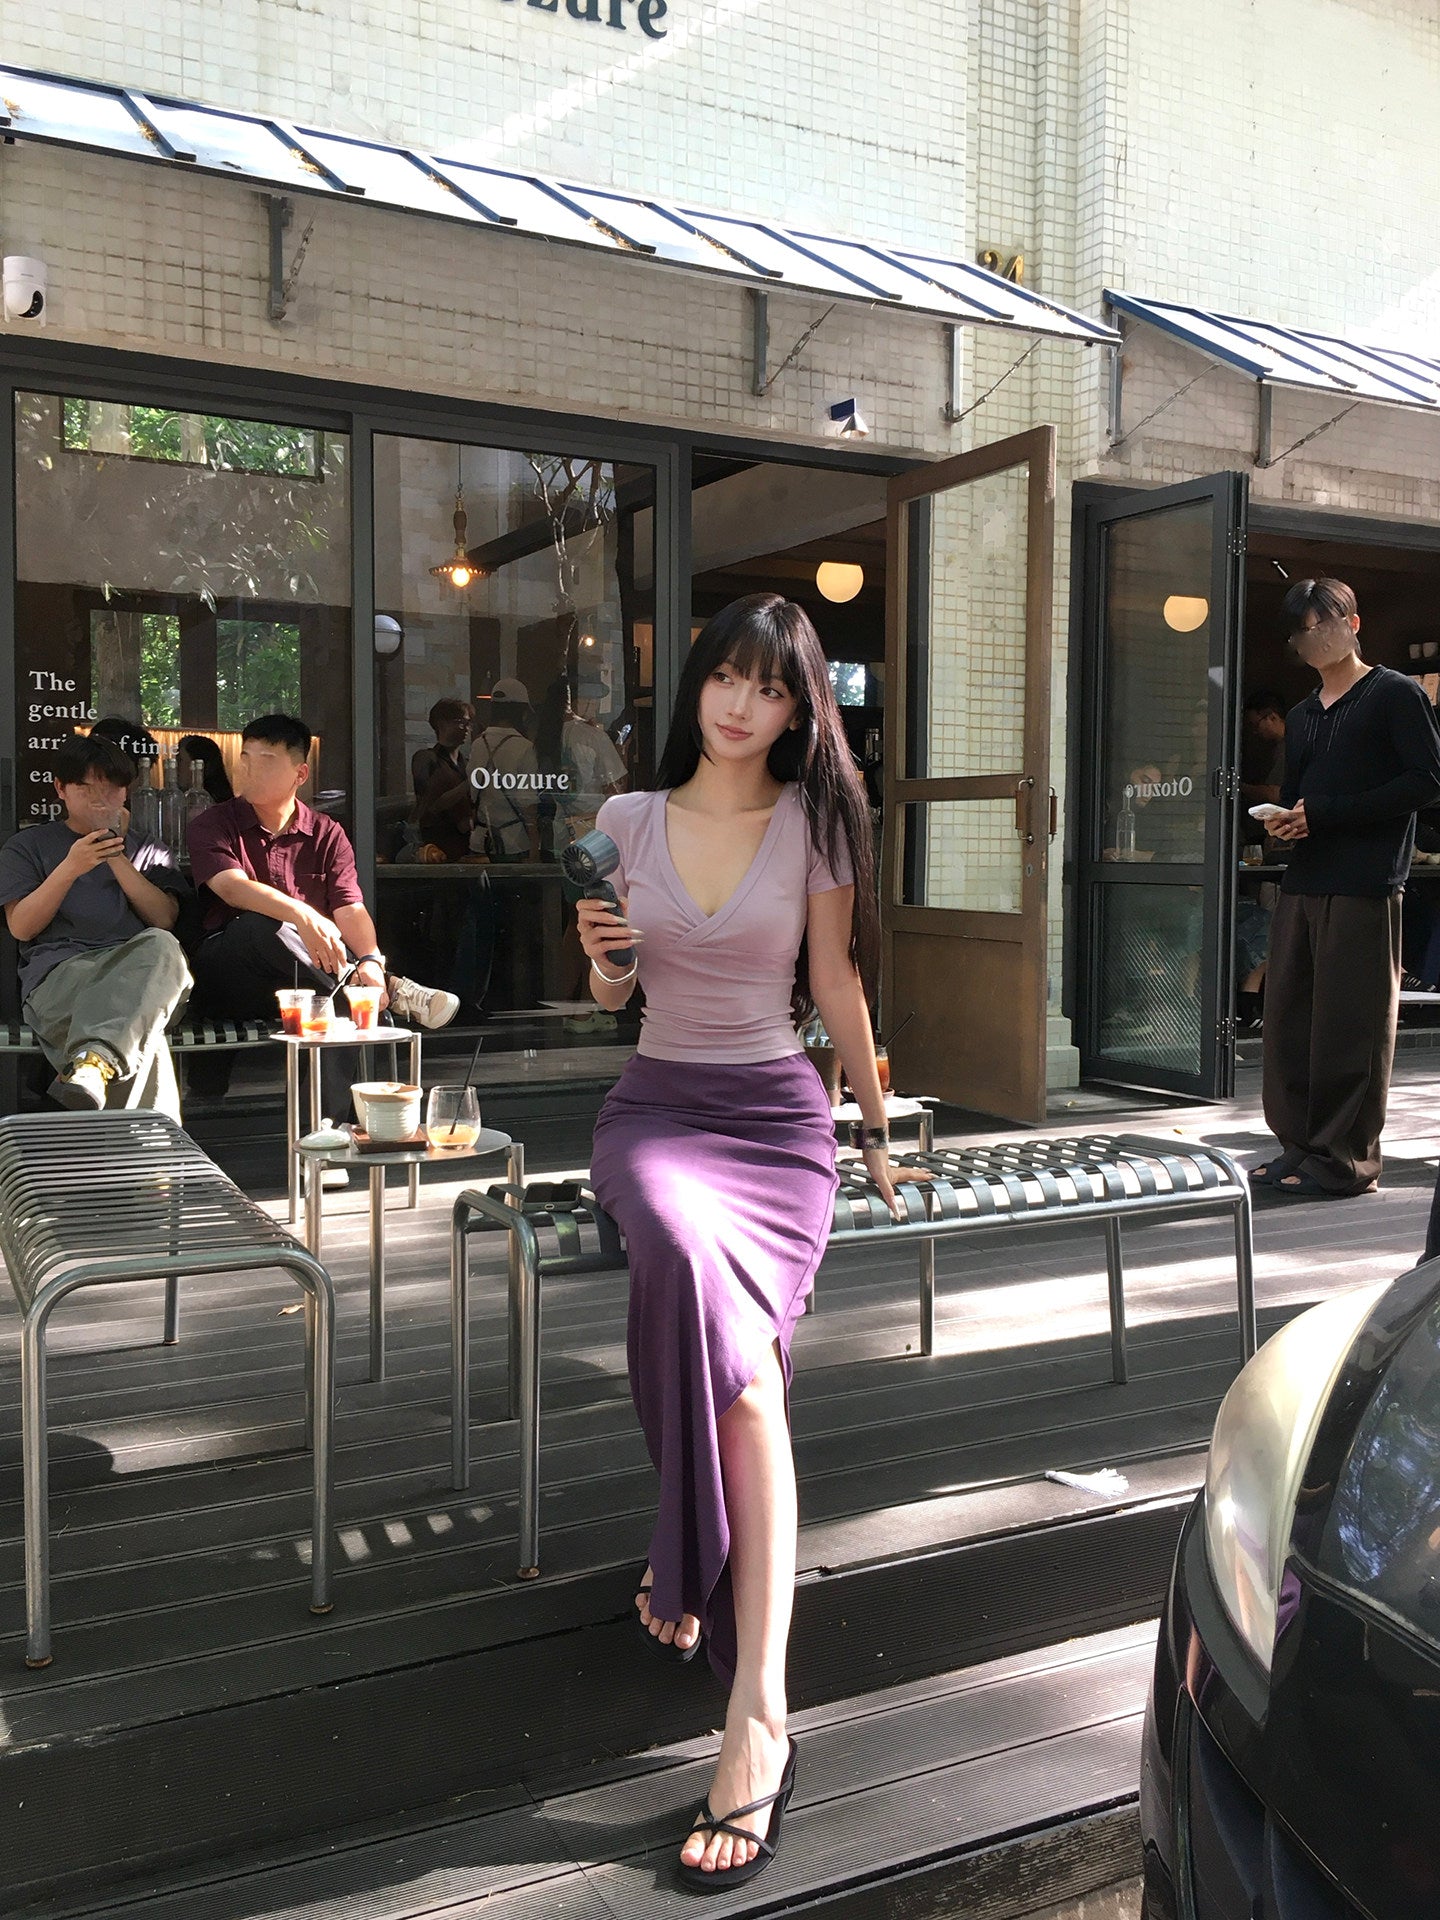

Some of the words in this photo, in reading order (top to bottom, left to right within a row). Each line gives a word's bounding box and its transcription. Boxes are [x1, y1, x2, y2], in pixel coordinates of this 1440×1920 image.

[28, 670, 76, 692] The
[28, 701, 98, 722] gentle
[131, 737, 180, 756] time
[470, 767, 569, 790] Otozure
[30, 798, 62, 822] sip
